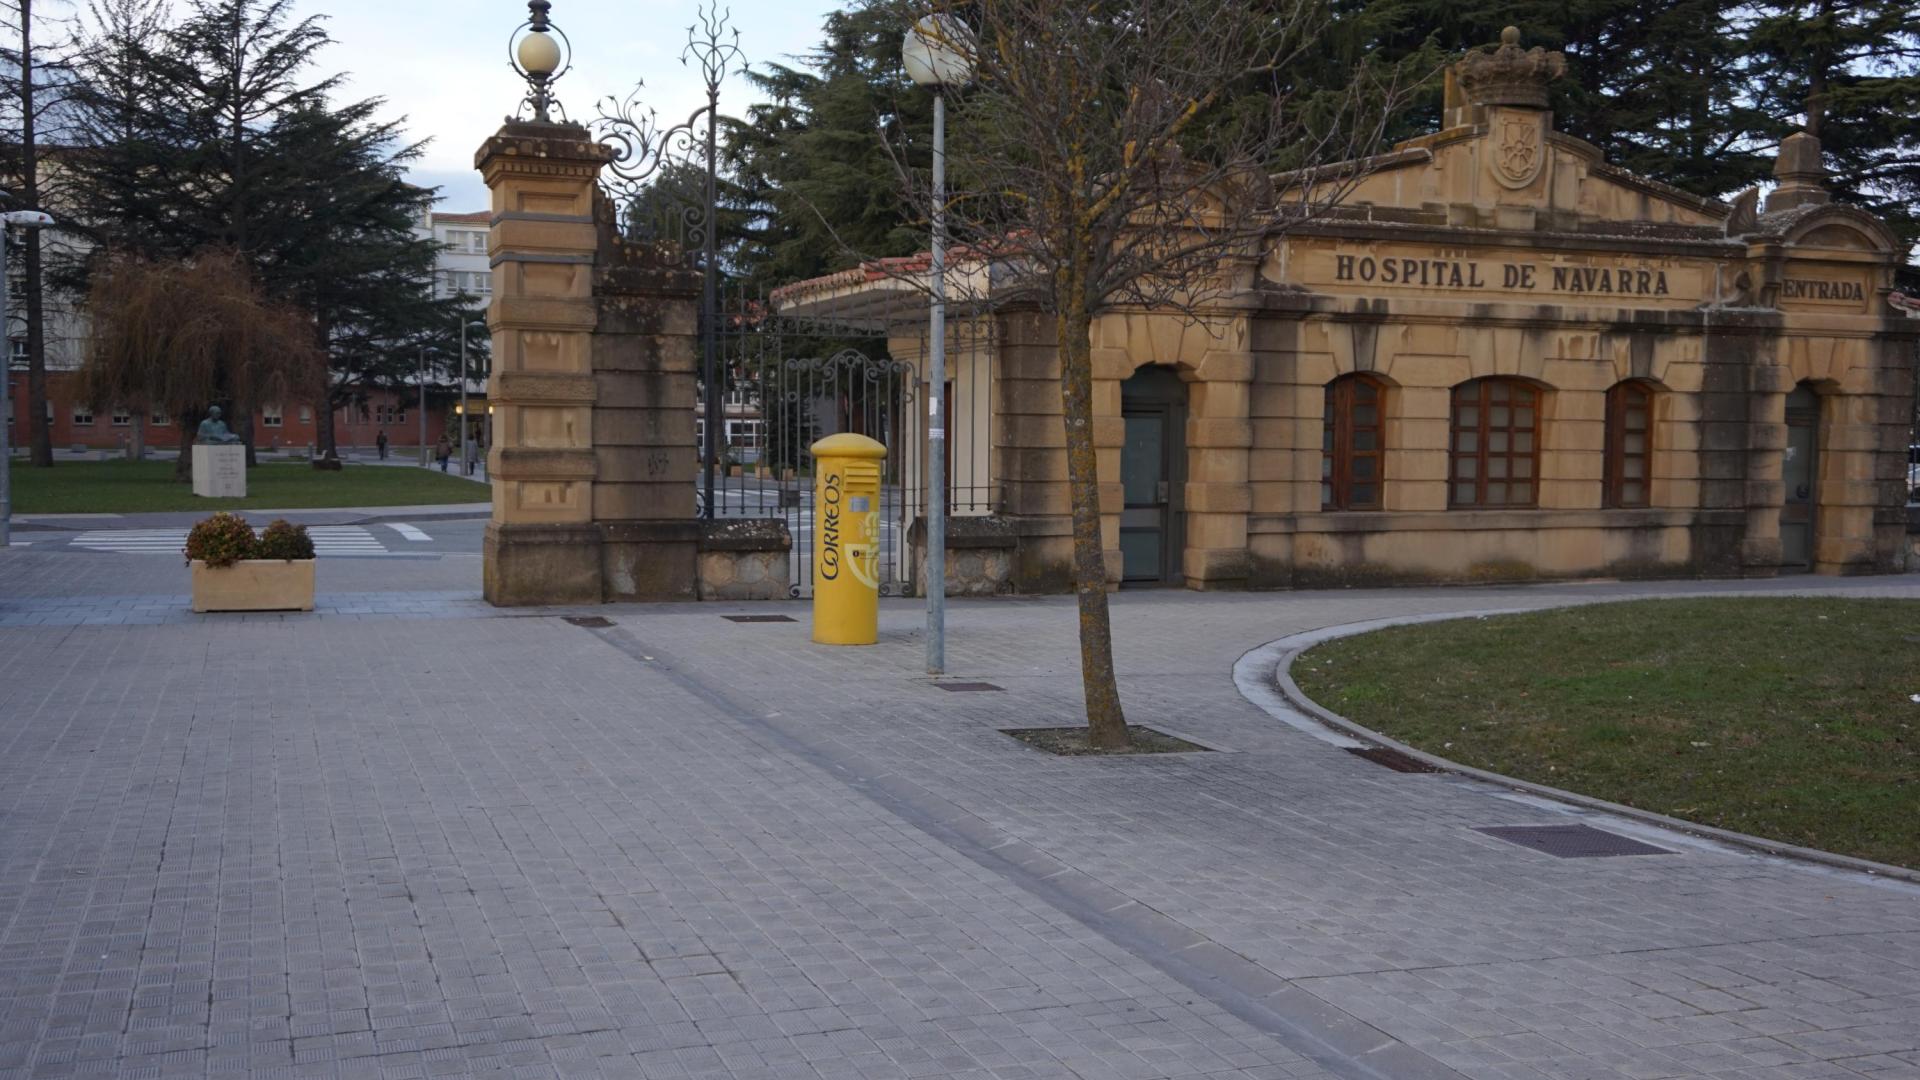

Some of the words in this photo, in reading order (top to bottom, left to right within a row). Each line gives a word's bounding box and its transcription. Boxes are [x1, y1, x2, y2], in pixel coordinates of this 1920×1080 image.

[1336, 255, 1484, 288] HOSPITAL
[1502, 264, 1536, 289] DE
[1552, 266, 1669, 295] NAVARRA
[1782, 279, 1864, 300] ENTRADA
[821, 473, 840, 580] CORREOS
